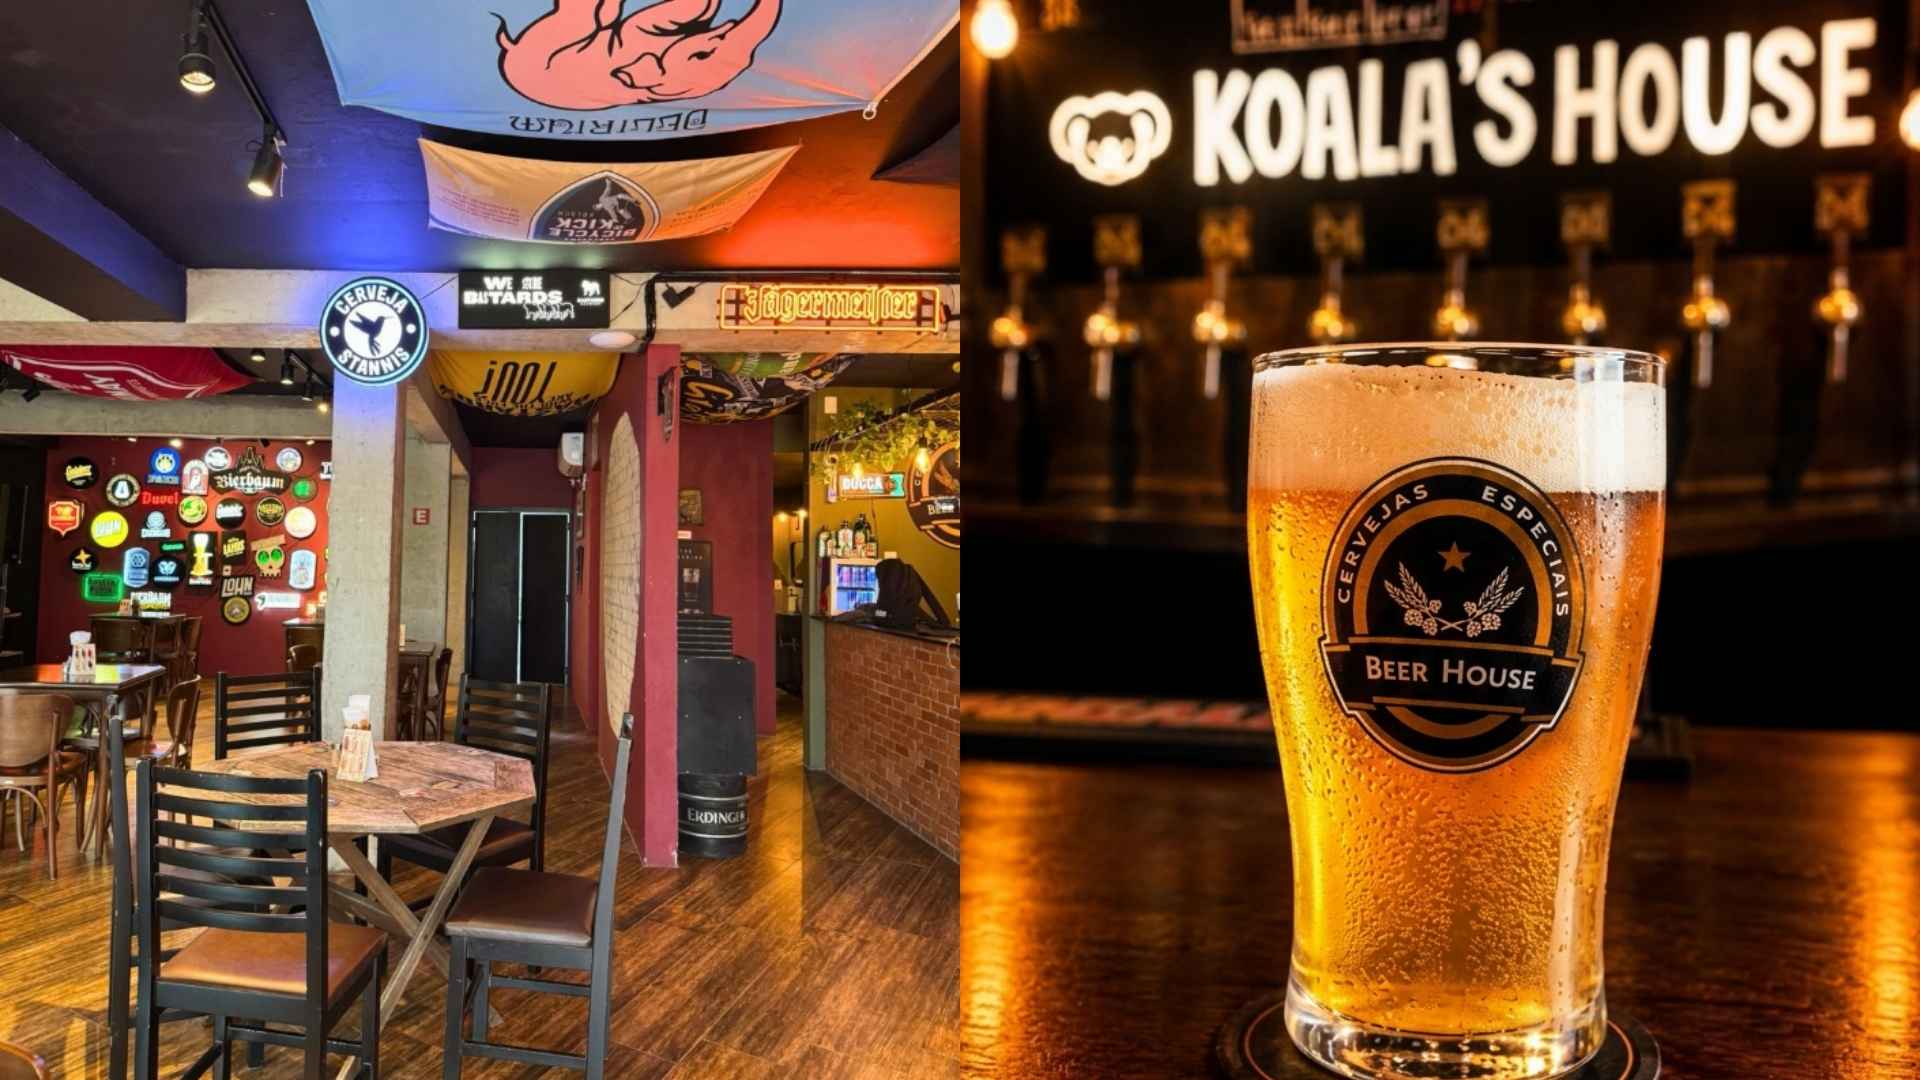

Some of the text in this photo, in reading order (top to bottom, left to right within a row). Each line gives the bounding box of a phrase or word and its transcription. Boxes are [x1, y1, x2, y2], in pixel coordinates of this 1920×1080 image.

[1192, 17, 1878, 188] KOALA'S HOUSE
[508, 108, 710, 136] DELIRIUM
[548, 227, 637, 238] BICYCLE
[556, 217, 615, 230] KICK
[483, 276, 513, 291] WE
[334, 284, 409, 315] CERVEJA
[338, 346, 410, 377] STANNIS
[214, 472, 285, 489] Bierbaum
[142, 491, 179, 505] Duvel
[416, 510, 427, 523] E
[1337, 484, 1429, 604] CERVEJAS
[1482, 485, 1569, 618] ESPECIAIS
[221, 576, 254, 598] LOHN
[1364, 655, 1537, 690] BEER HOUSE
